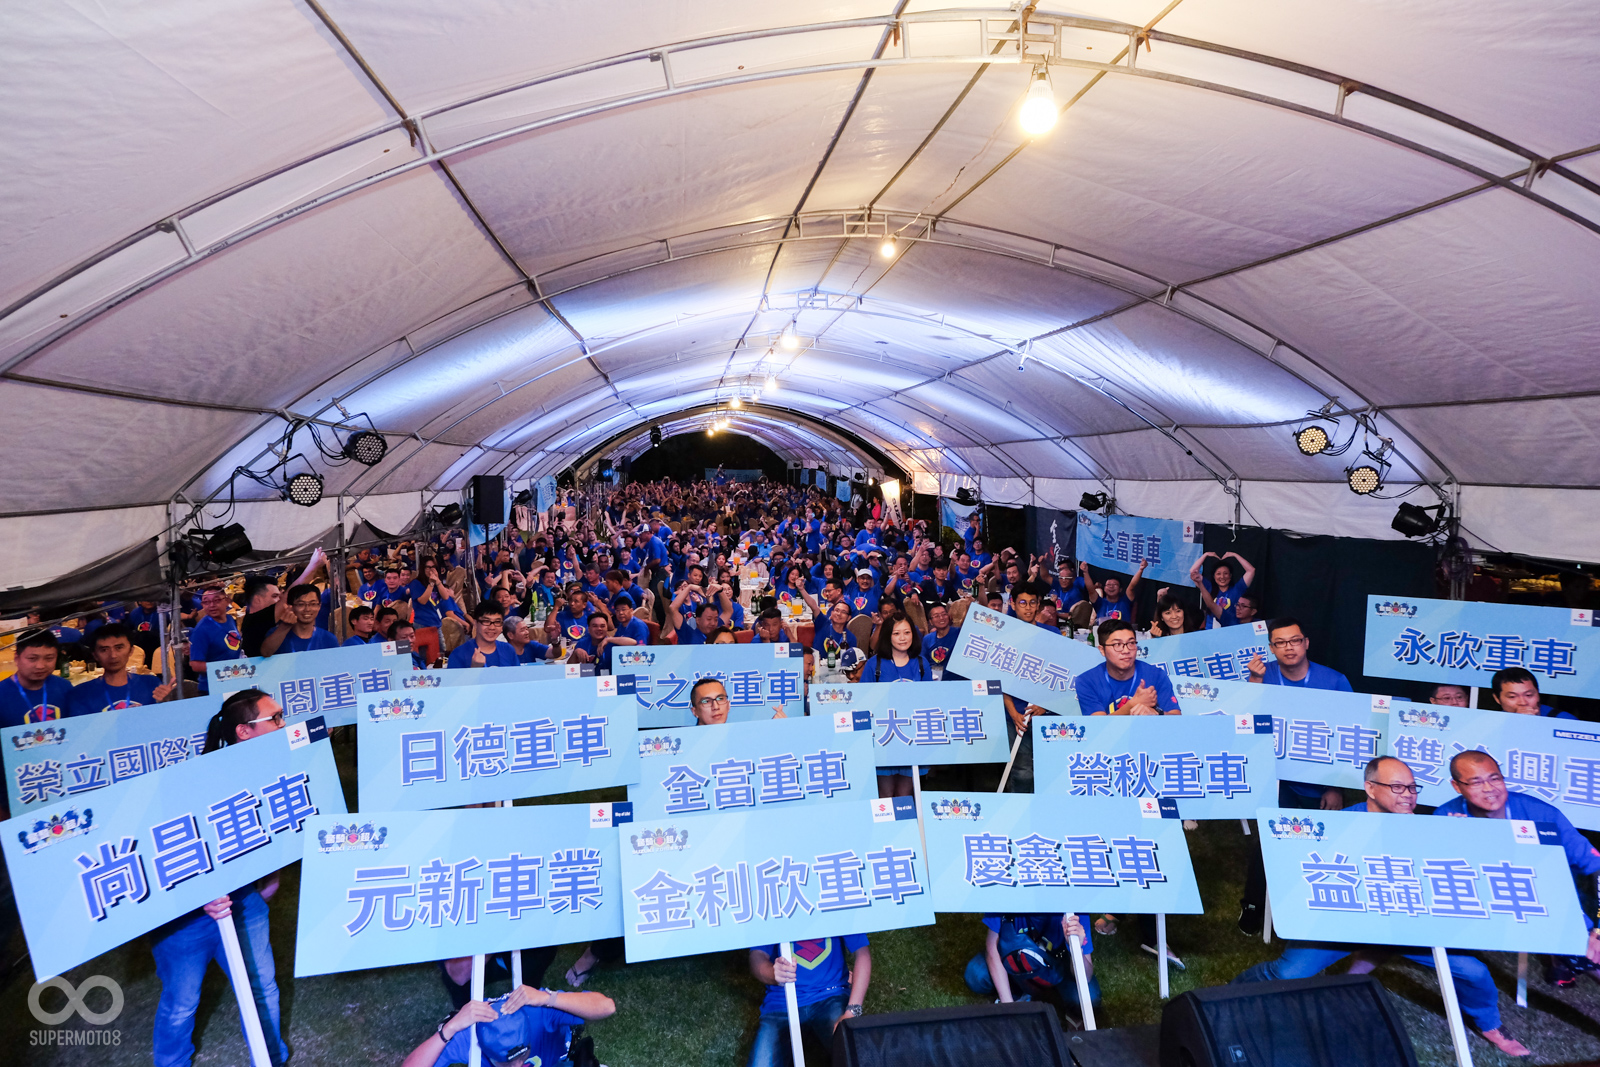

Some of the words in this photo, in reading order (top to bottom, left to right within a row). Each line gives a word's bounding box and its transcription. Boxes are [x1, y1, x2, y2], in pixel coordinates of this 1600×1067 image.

[1102, 530, 1161, 567] 全富重車
[1156, 645, 1267, 682] 馬車業
[1393, 626, 1577, 677] 永欣重車
[251, 668, 392, 718] 閤重車
[401, 713, 611, 786] 日德重車
[872, 706, 987, 747] 大重車
[662, 749, 850, 814] 全富重車
[1068, 752, 1250, 799] 榮秋重車
[77, 771, 316, 921] 尚昌重車
[963, 833, 1166, 889] 慶鑫重車
[345, 848, 603, 936] 元新車業
[632, 846, 922, 935] 金利欣重車
[1301, 852, 1549, 922] 益轟重車
